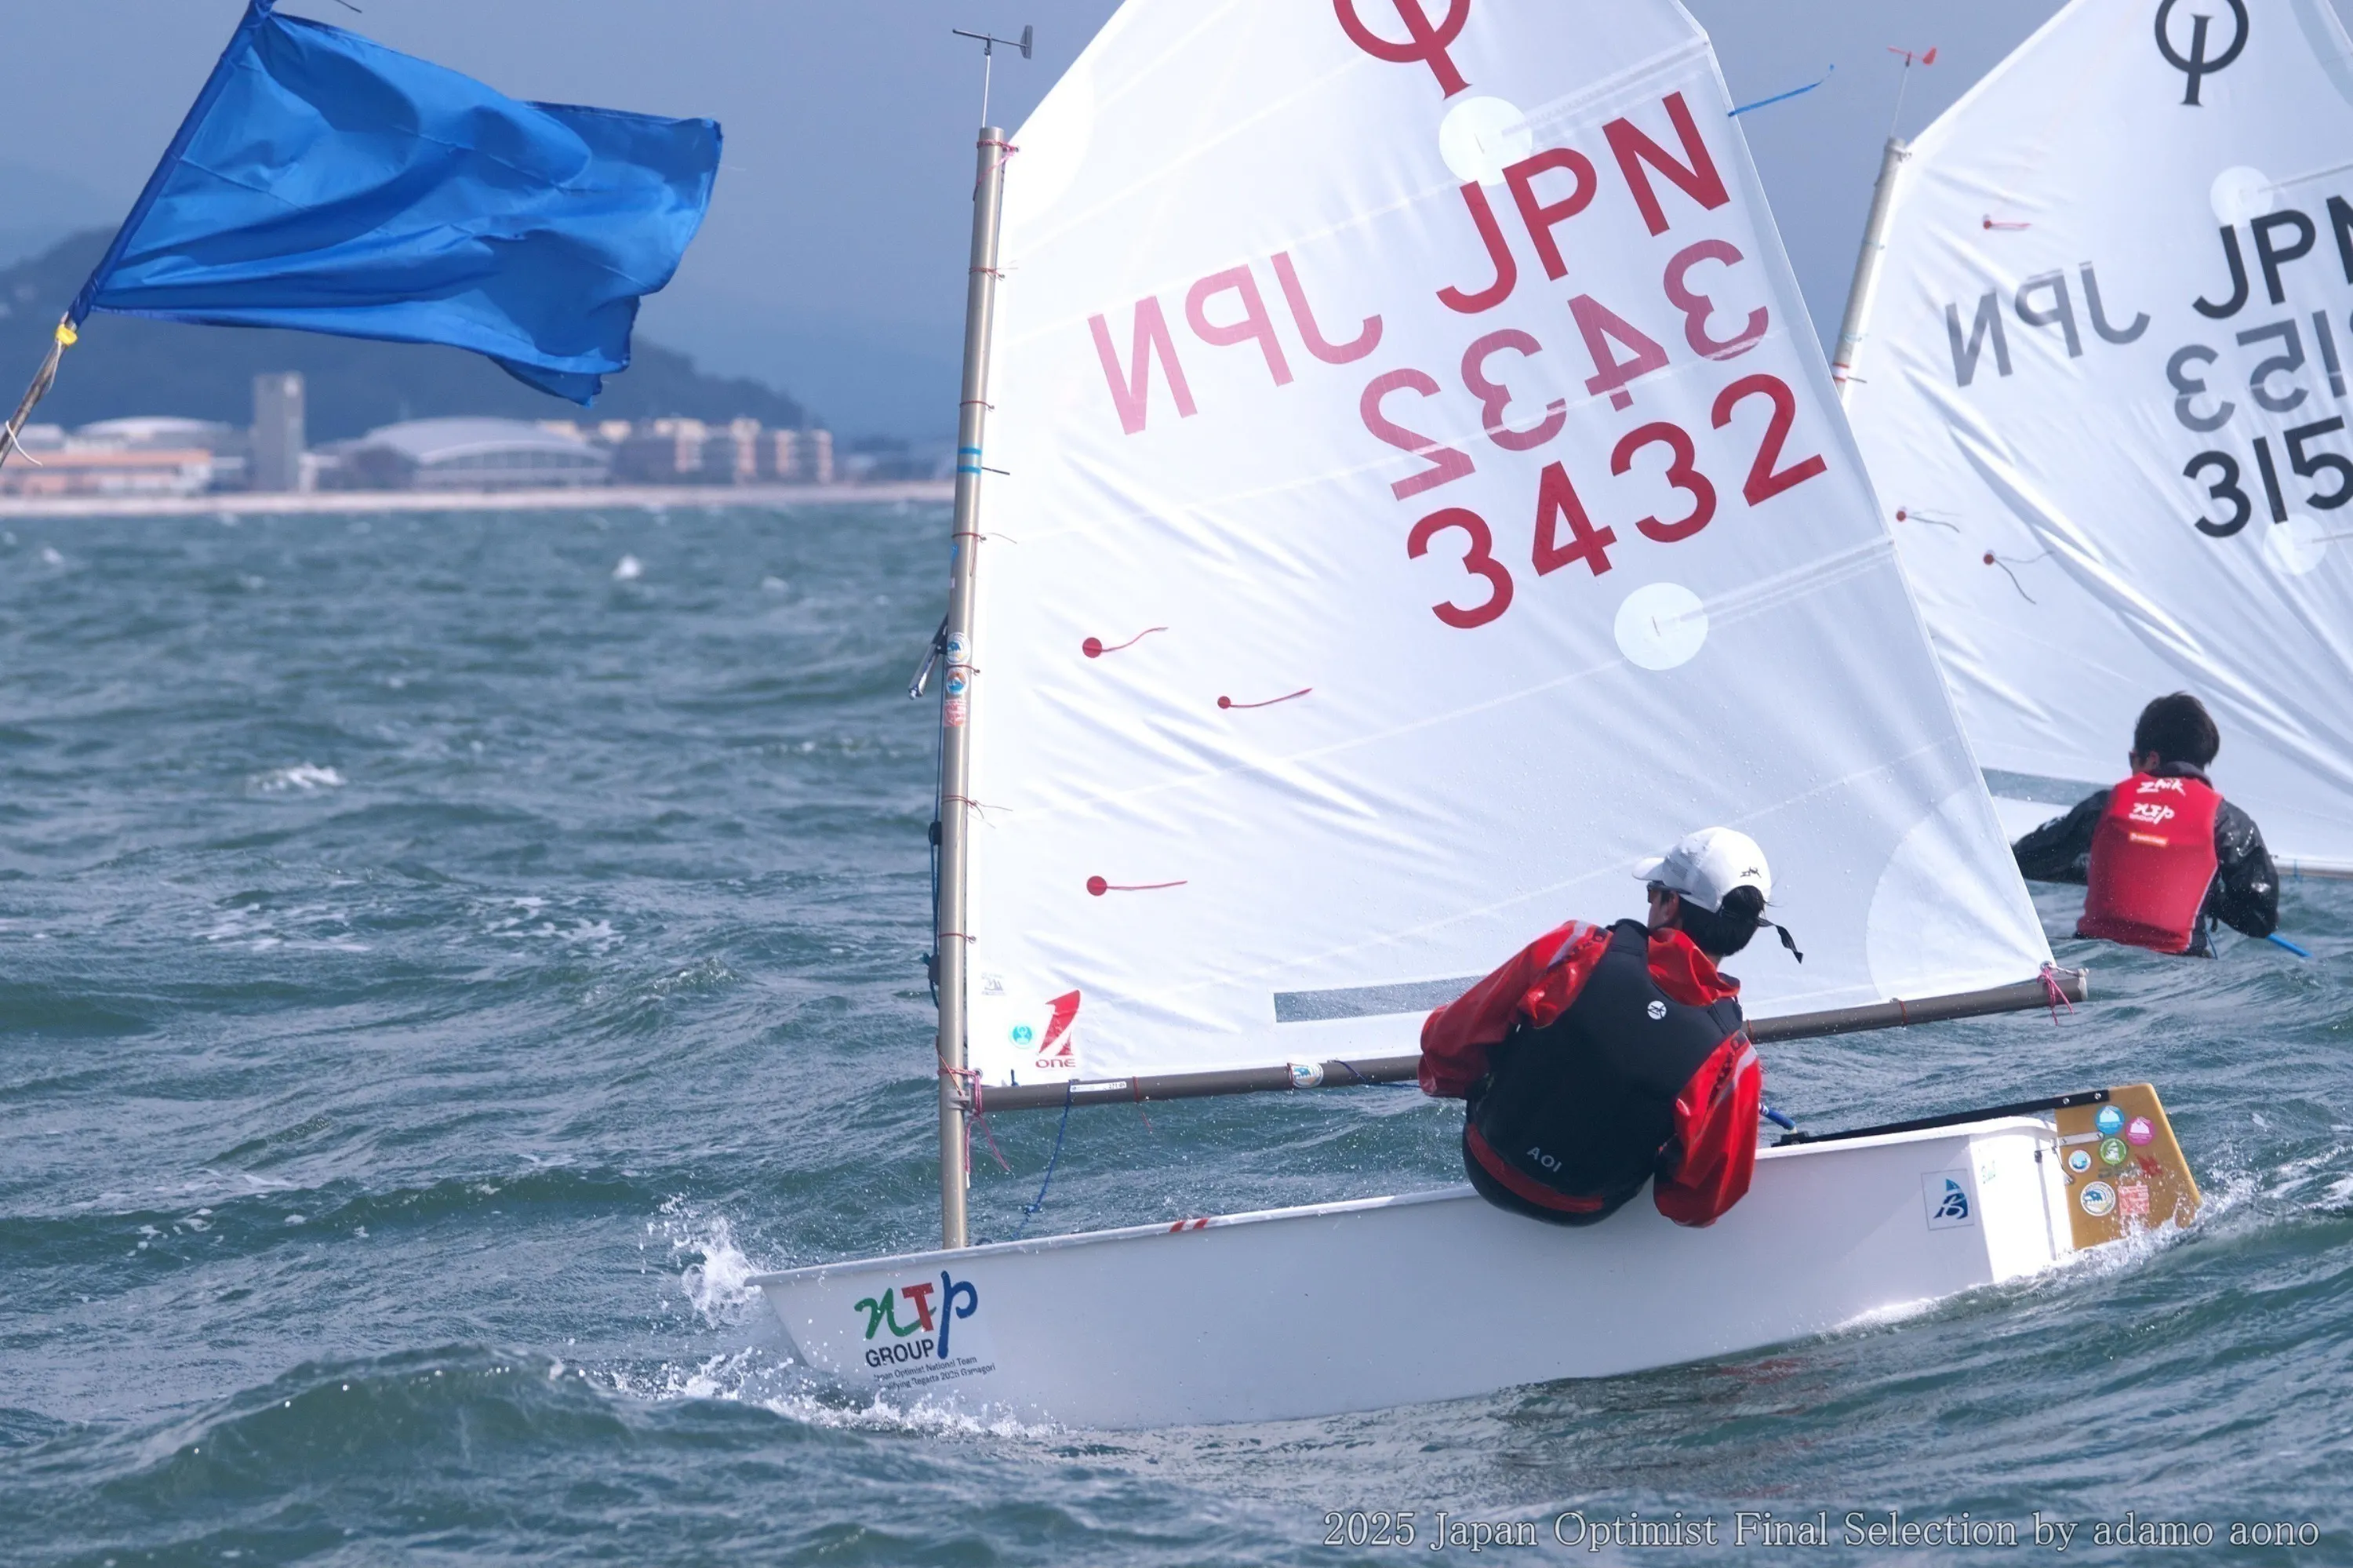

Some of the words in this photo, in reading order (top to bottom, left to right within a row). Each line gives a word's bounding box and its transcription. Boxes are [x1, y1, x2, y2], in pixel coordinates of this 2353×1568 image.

[1435, 91, 1730, 314] JPN
[1406, 373, 1827, 629] 3432
[1035, 1058, 1076, 1068] ONE
[1526, 1146, 1562, 1172] AOI
[865, 1338, 934, 1367] GROUP
[956, 1356, 977, 1366] Team
